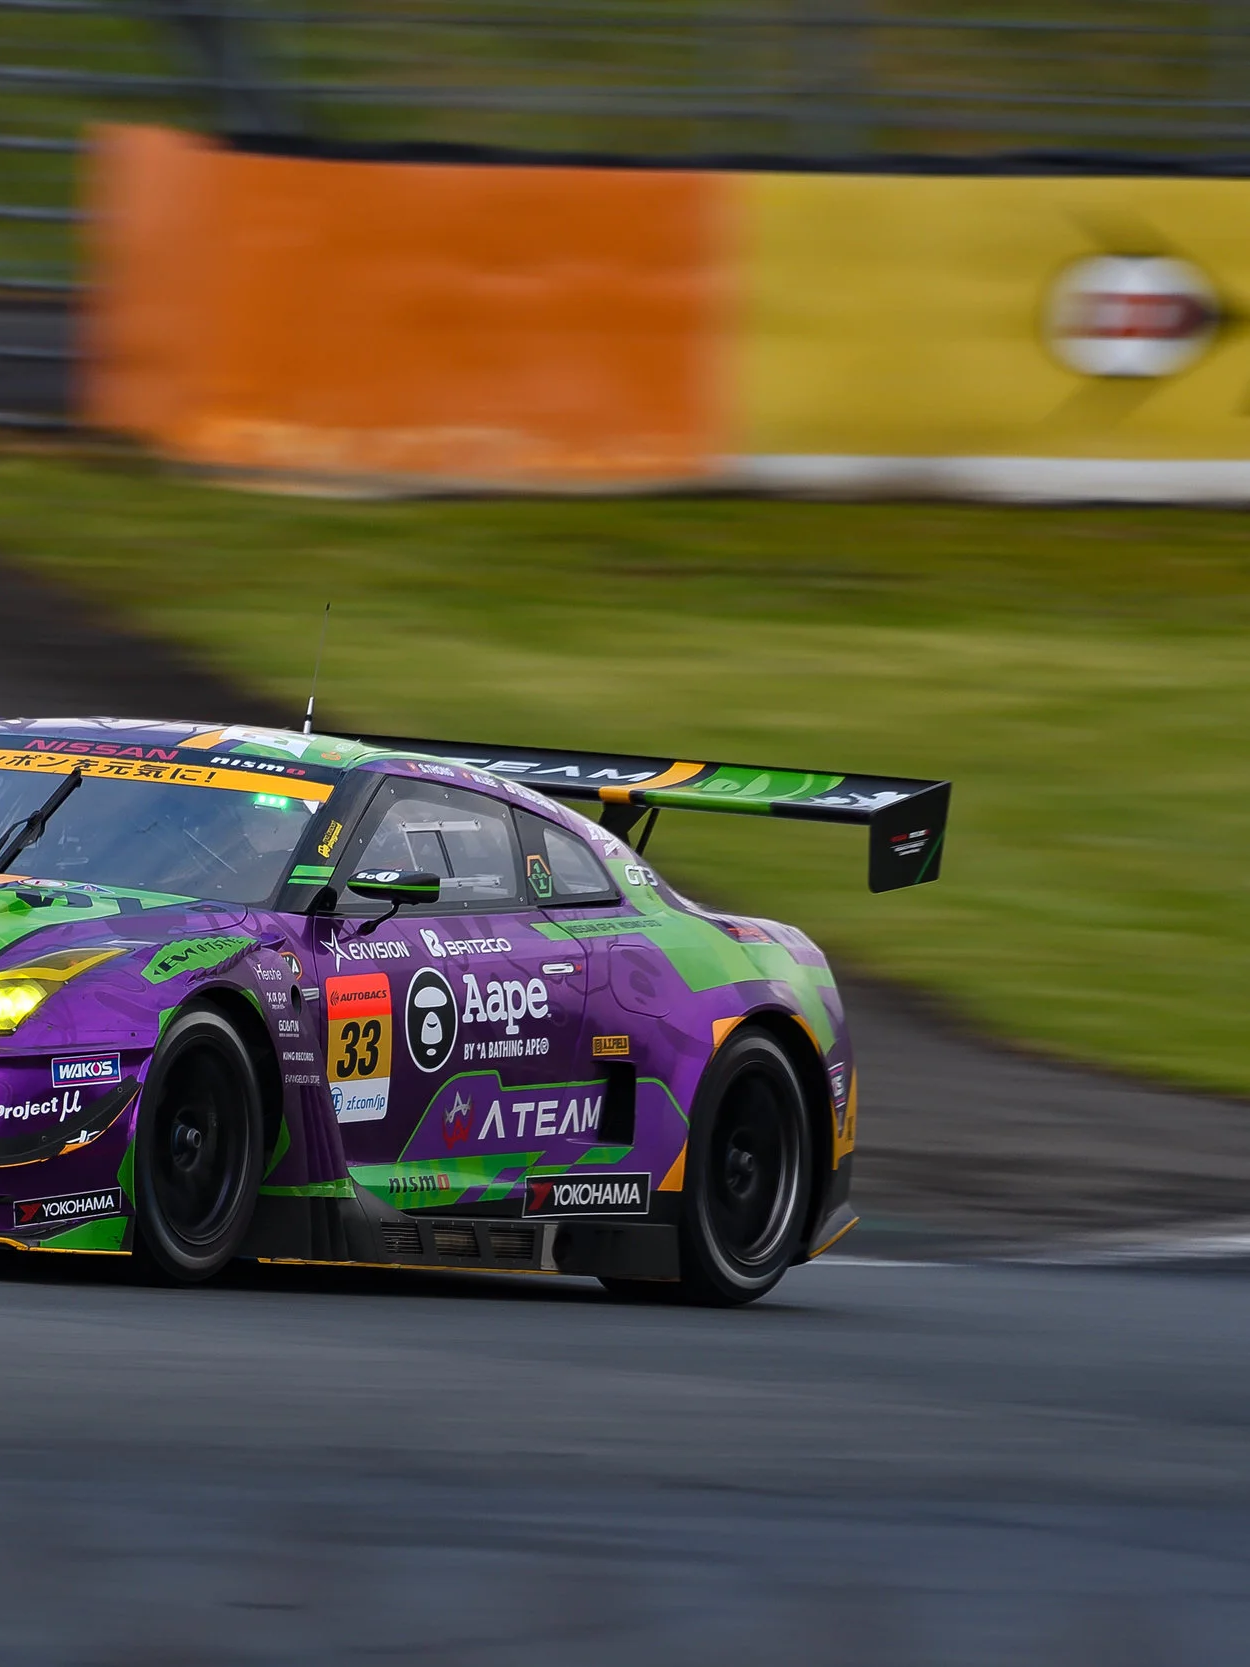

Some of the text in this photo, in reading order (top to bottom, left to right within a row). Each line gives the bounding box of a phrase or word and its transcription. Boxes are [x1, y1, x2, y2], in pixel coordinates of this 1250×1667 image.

[23, 738, 179, 761] NISSAN
[210, 756, 306, 776] nismo
[340, 990, 387, 1002] AUTOBACS
[462, 973, 549, 1035] Aape
[336, 1019, 382, 1078] 33
[464, 1043, 474, 1061] BY
[488, 1039, 523, 1058] BATHING
[346, 1093, 386, 1111] zf.com/jp
[511, 1095, 603, 1138] TEAM
[388, 1173, 451, 1194] nismo
[553, 1183, 642, 1206] YOKOHAMA
[42, 1194, 115, 1217] YOKOHAMA
